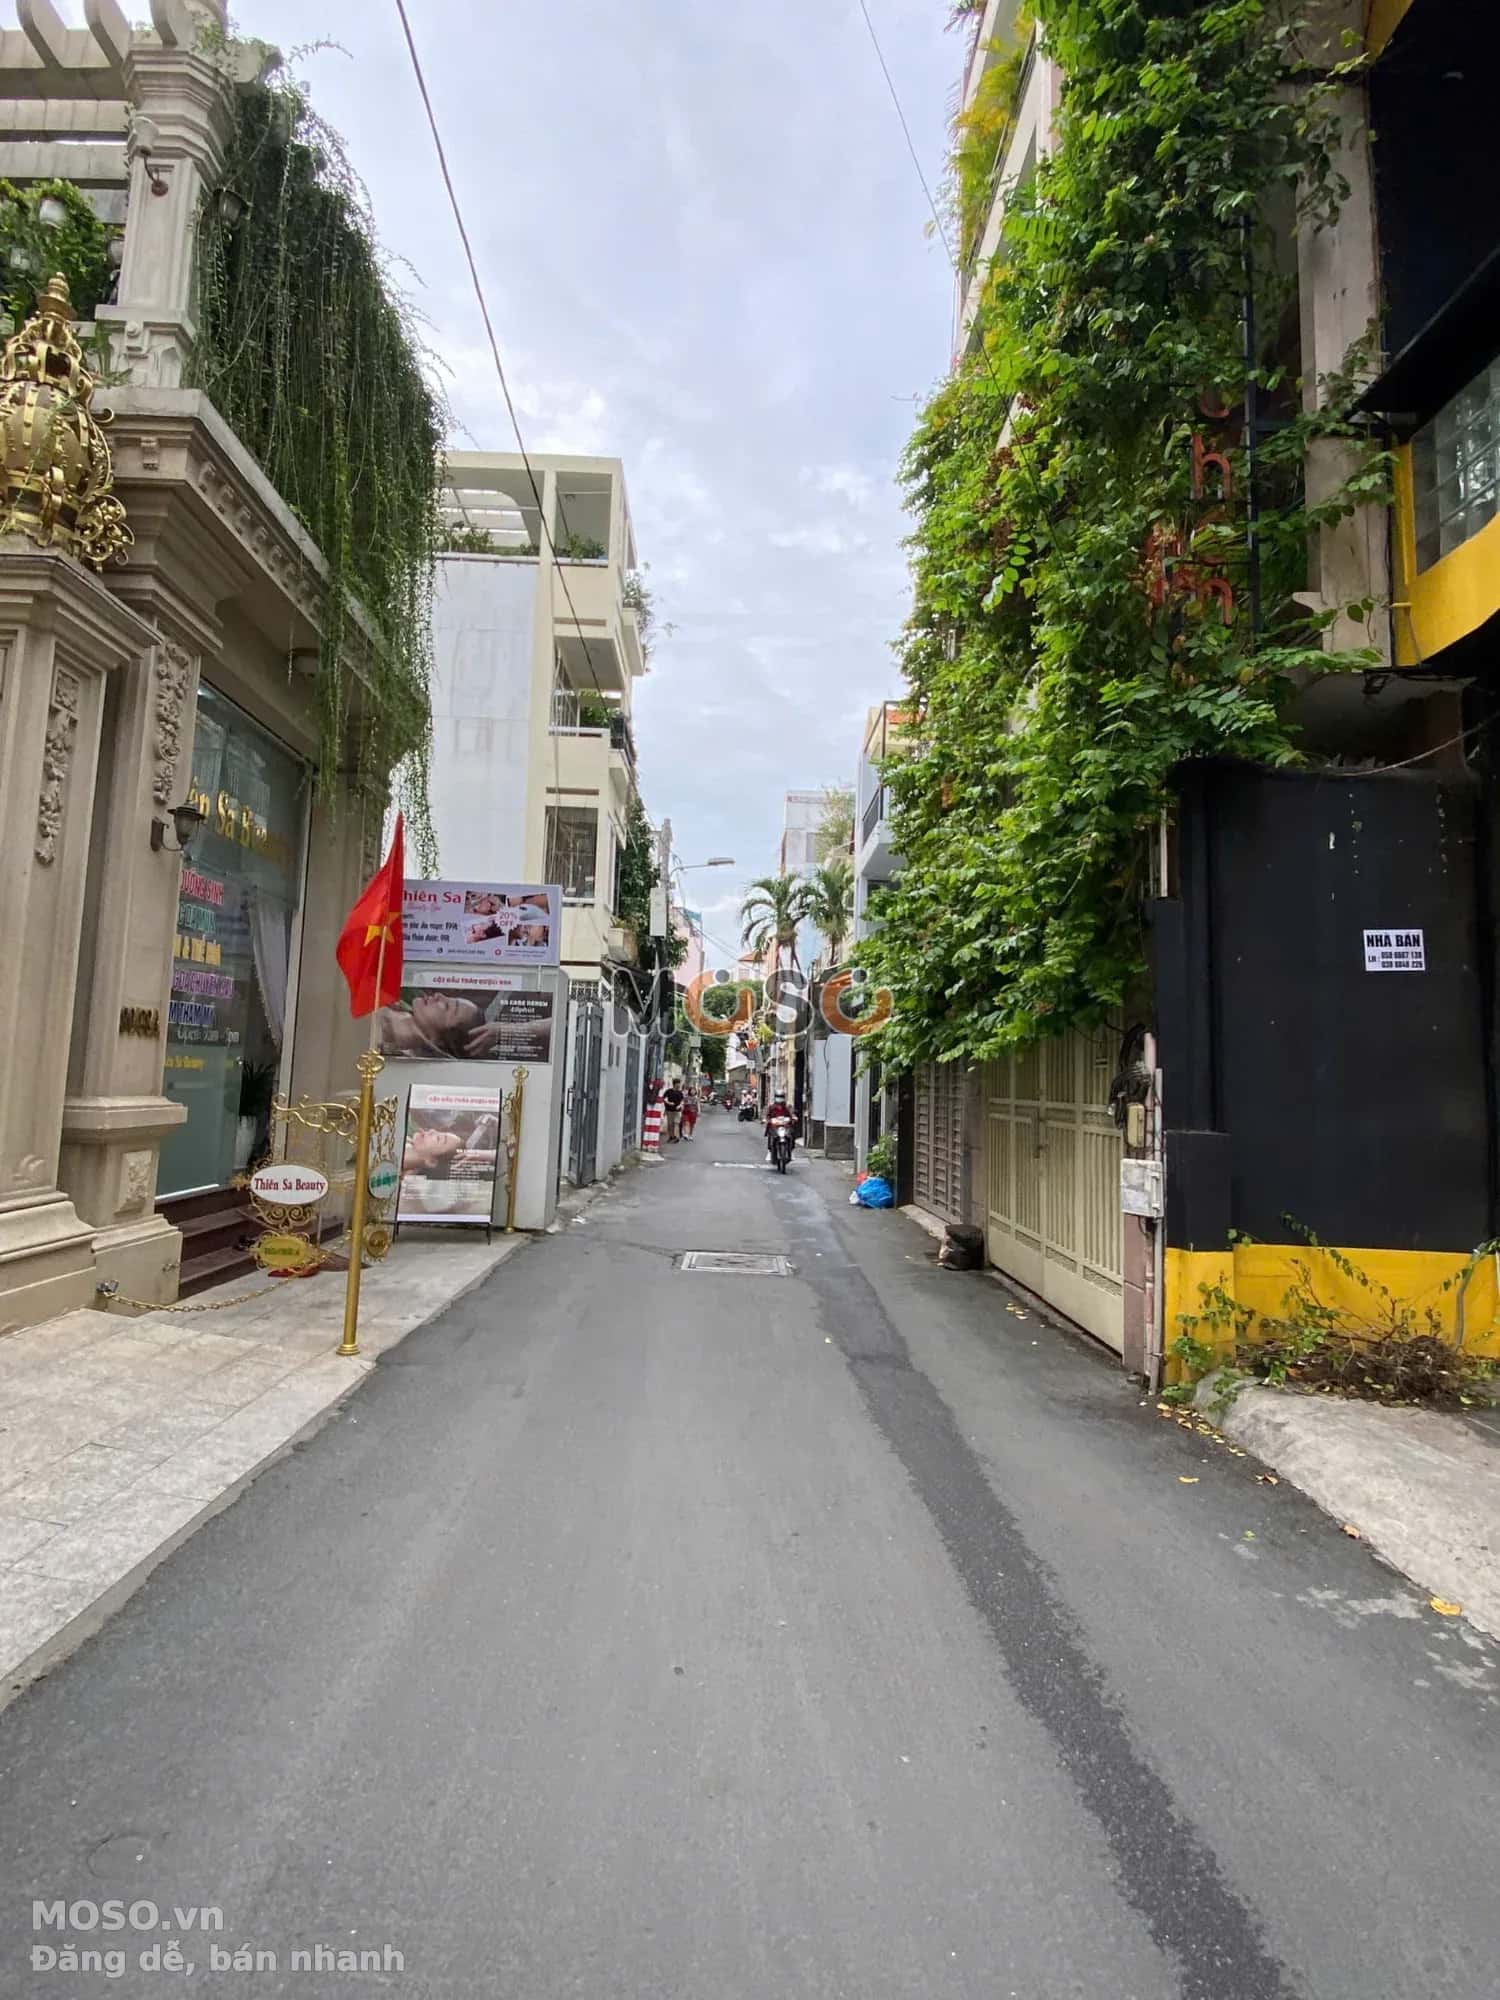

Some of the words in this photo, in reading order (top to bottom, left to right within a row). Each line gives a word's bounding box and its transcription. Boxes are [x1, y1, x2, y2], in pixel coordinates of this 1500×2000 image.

[402, 889, 437, 903] hiên
[443, 891, 462, 904] Sa
[282, 1177, 293, 1191] Sa
[295, 1177, 327, 1194] Beauty
